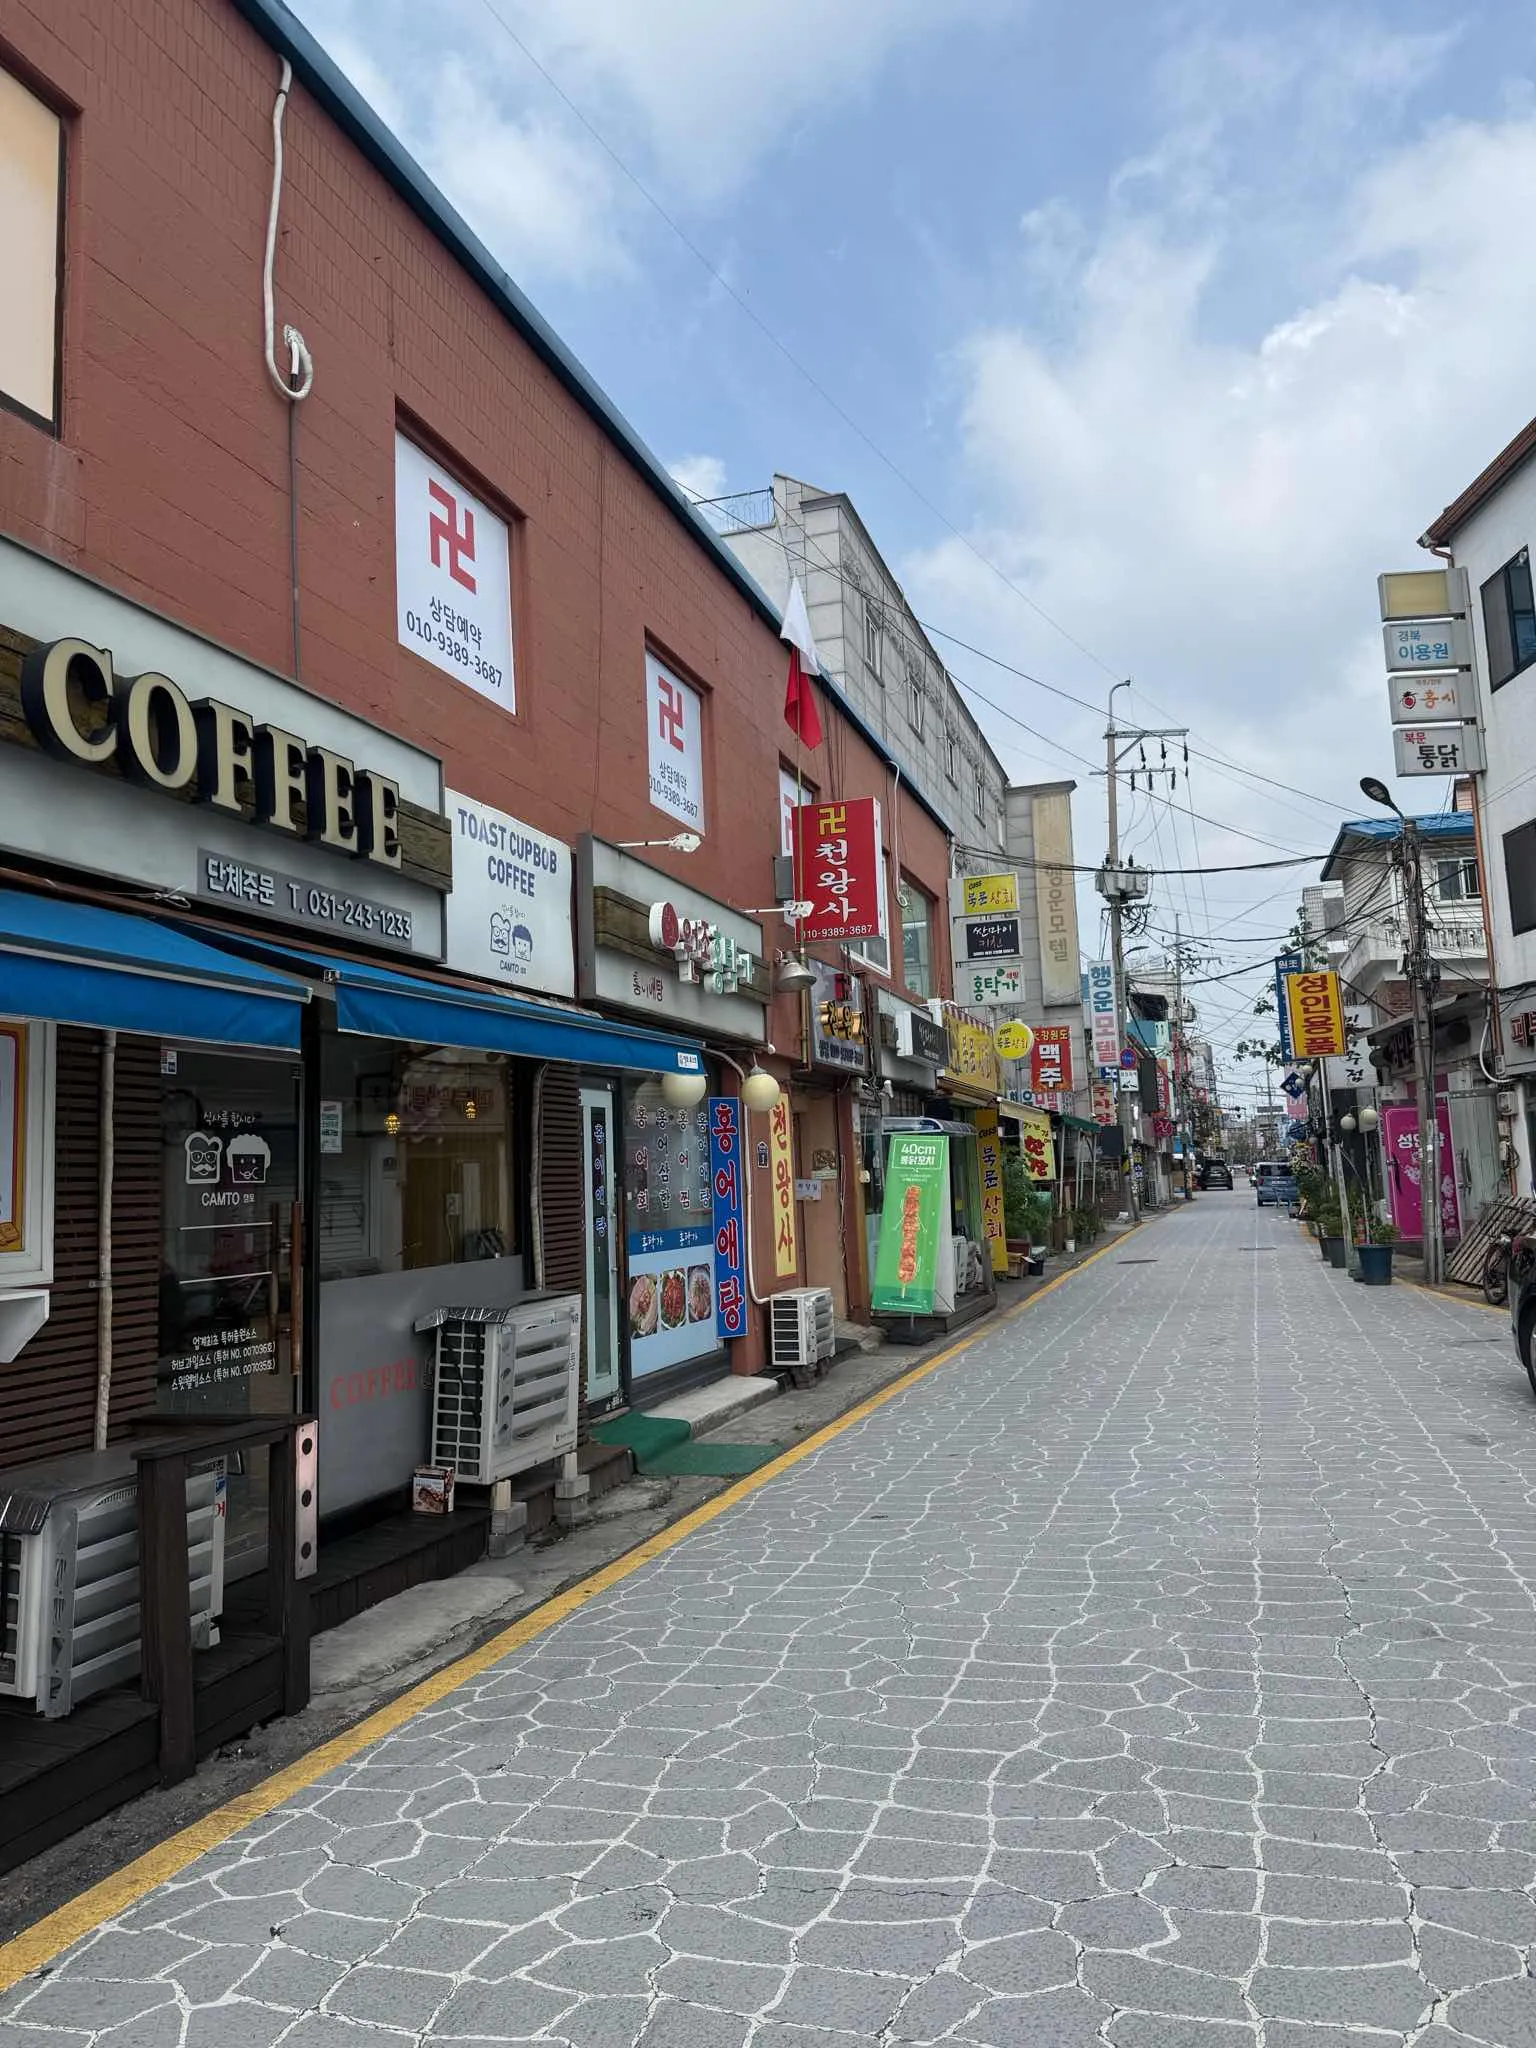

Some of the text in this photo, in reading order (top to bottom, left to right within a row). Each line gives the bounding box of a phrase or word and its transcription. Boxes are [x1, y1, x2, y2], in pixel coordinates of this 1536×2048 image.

[429, 595, 483, 651] 상담예약
[406, 610, 503, 688] 010-9389-3687
[1399, 642, 1449, 661] 이용원
[1423, 689, 1456, 710] 홍시
[24, 637, 403, 870] COFFEE
[1404, 732, 1427, 744] 북문
[1417, 744, 1460, 769] 통닭
[659, 760, 688, 794] 상담예약
[457, 807, 557, 875] TOAST CUPBOB
[487, 855, 535, 898] COFFEE
[814, 838, 858, 923] 천왕사
[206, 858, 275, 906] 단체주문
[309, 891, 412, 940] 031-243-1233
[801, 924, 873, 939] 10-9389-3687
[973, 975, 1019, 1002] 홍탁가
[1090, 965, 1117, 1063] 행운모텔
[1296, 974, 1338, 1056] 성인용품
[1039, 1044, 1063, 1089] 맥주
[203, 1110, 229, 1128] 식사를
[901, 1143, 936, 1155] 40cm
[201, 1192, 240, 1206] CAMTO
[772, 1101, 794, 1263] 천왕사
[982, 1145, 1003, 1239] 북문상회
[712, 1103, 744, 1331] 홍어애탕
[230, 1348, 242, 1360] NO.
[230, 1366, 242, 1377] NO.
[330, 1358, 417, 1410] COFFEE
